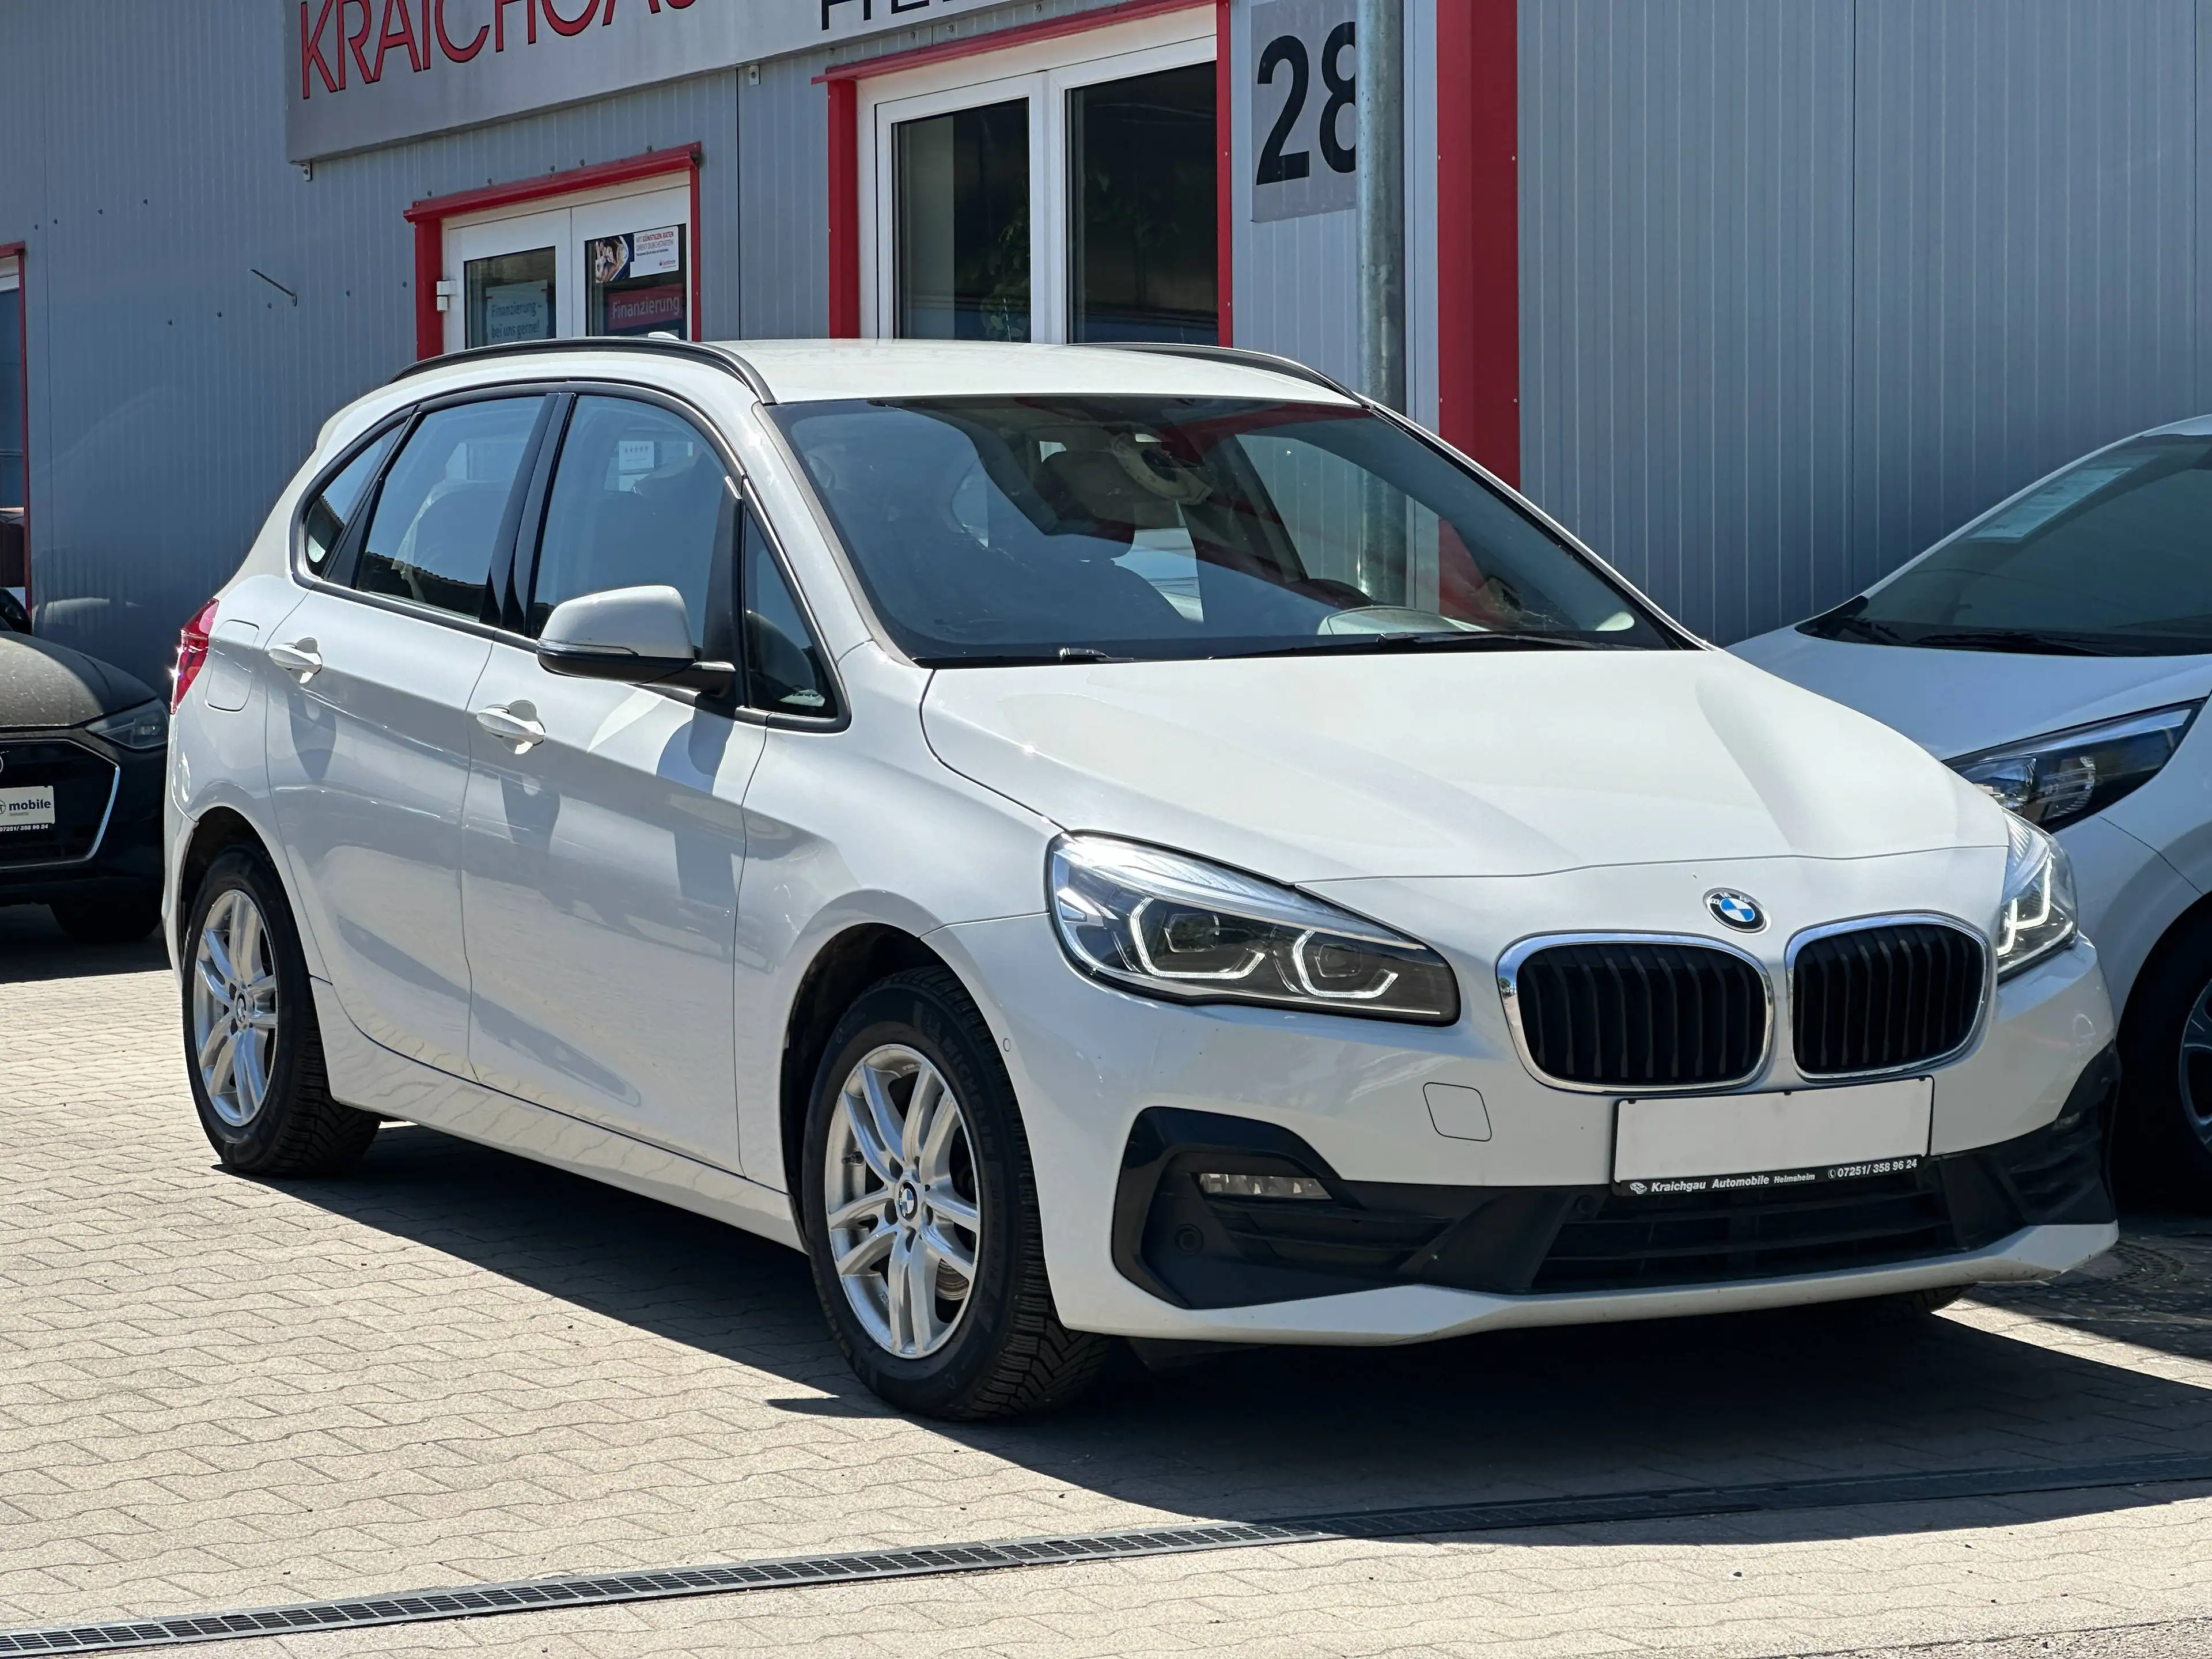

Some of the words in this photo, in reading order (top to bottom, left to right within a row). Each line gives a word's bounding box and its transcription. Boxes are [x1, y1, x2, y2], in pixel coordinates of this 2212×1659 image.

[301, 0, 697, 100] KRAICH
[1256, 21, 1356, 185] 28
[612, 297, 680, 320] Finanzierung
[491, 323, 502, 338] bei
[503, 325, 516, 336] uns
[9, 799, 51, 811] mobile
[940, 1036, 997, 1156] MICHELIN
[1651, 1180, 1706, 1192] Kraichgau
[1711, 1175, 1770, 1189] Automobile
[1837, 1164, 1872, 1177] 07251/
[1873, 1162, 1891, 1173] 358
[1893, 1160, 1904, 1171] 96
[1906, 1158, 1918, 1169] 24
